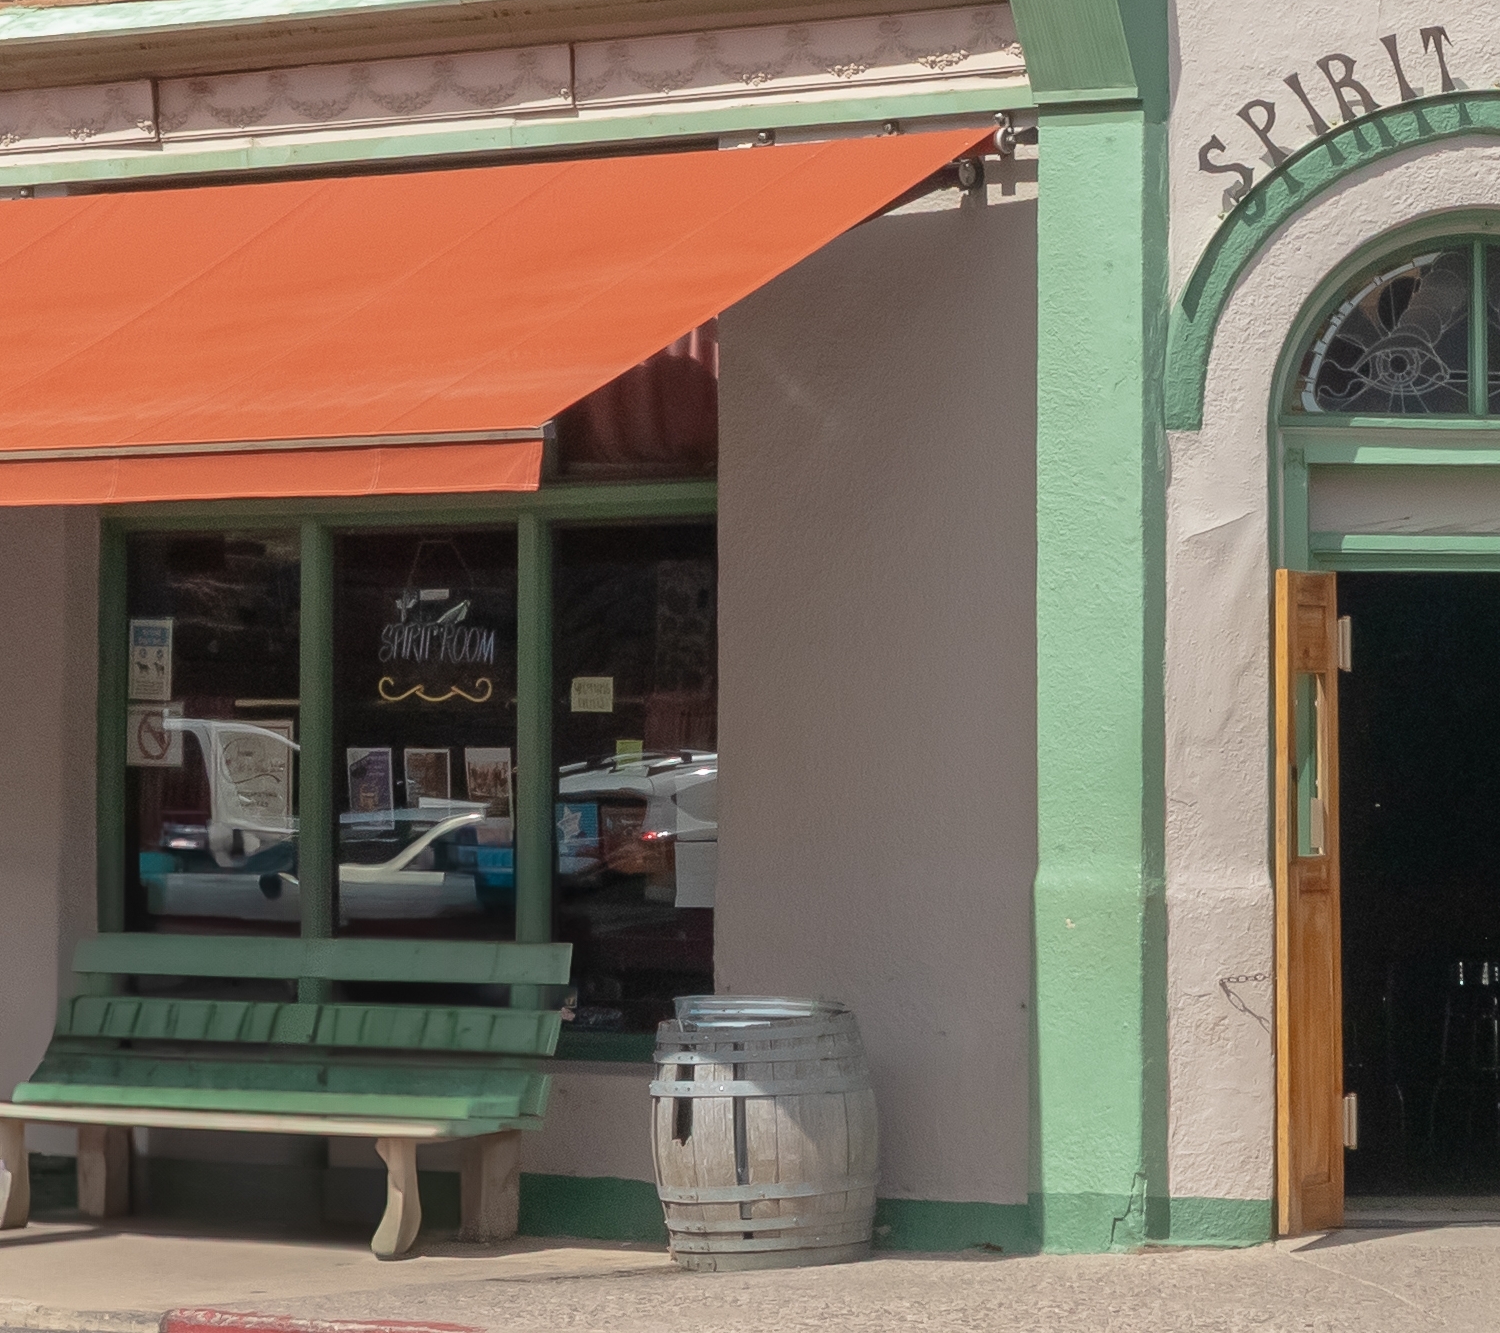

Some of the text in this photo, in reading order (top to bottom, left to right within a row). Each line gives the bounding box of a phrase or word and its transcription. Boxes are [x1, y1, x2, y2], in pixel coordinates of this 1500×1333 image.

[1199, 25, 1457, 191] SPIRIT
[378, 622, 496, 665] SPIRIT ROOM
